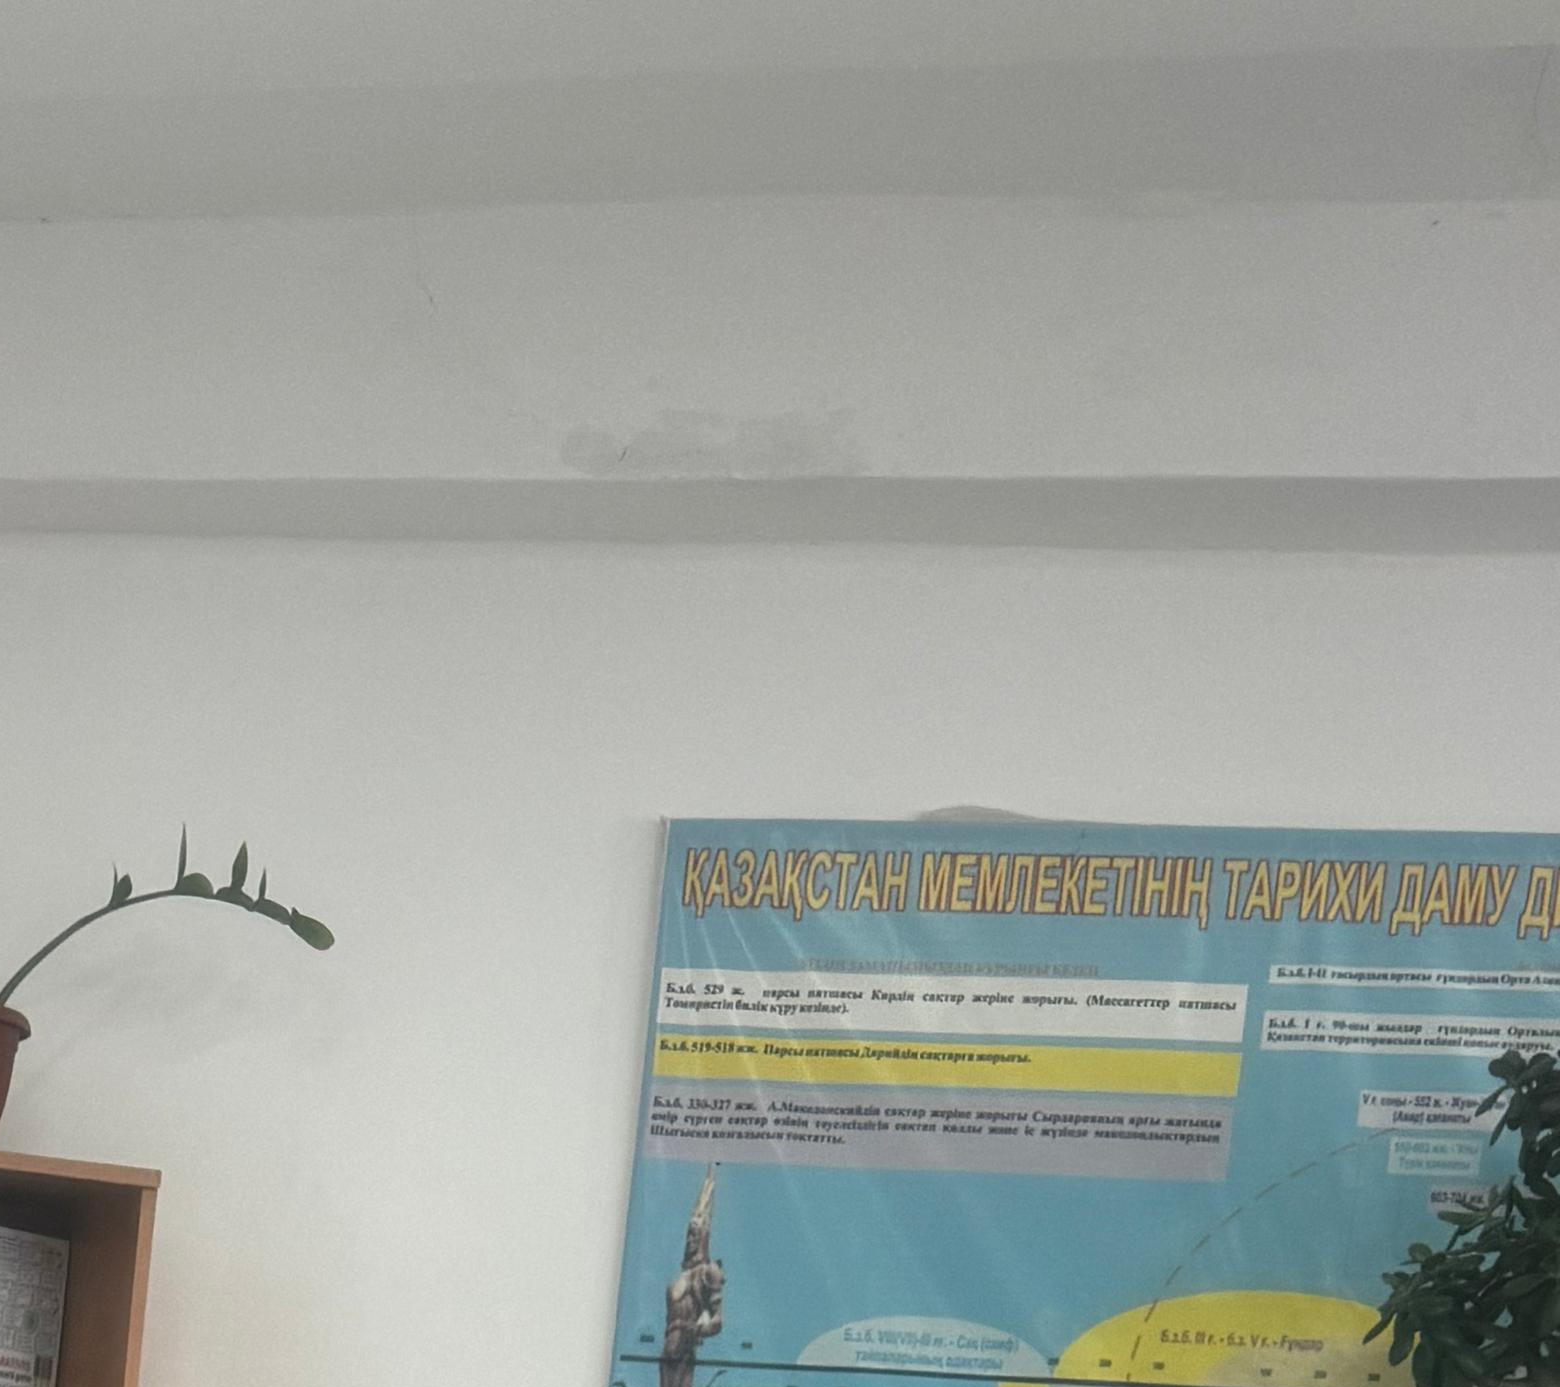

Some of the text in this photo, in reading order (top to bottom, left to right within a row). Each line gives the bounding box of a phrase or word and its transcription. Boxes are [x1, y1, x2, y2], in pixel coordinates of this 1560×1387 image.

[681, 847, 1560, 941] ҚАЗАҚСТАН МЕМЛЕКЕТІНІҢ ТАРИХИ ДАМУ Д
